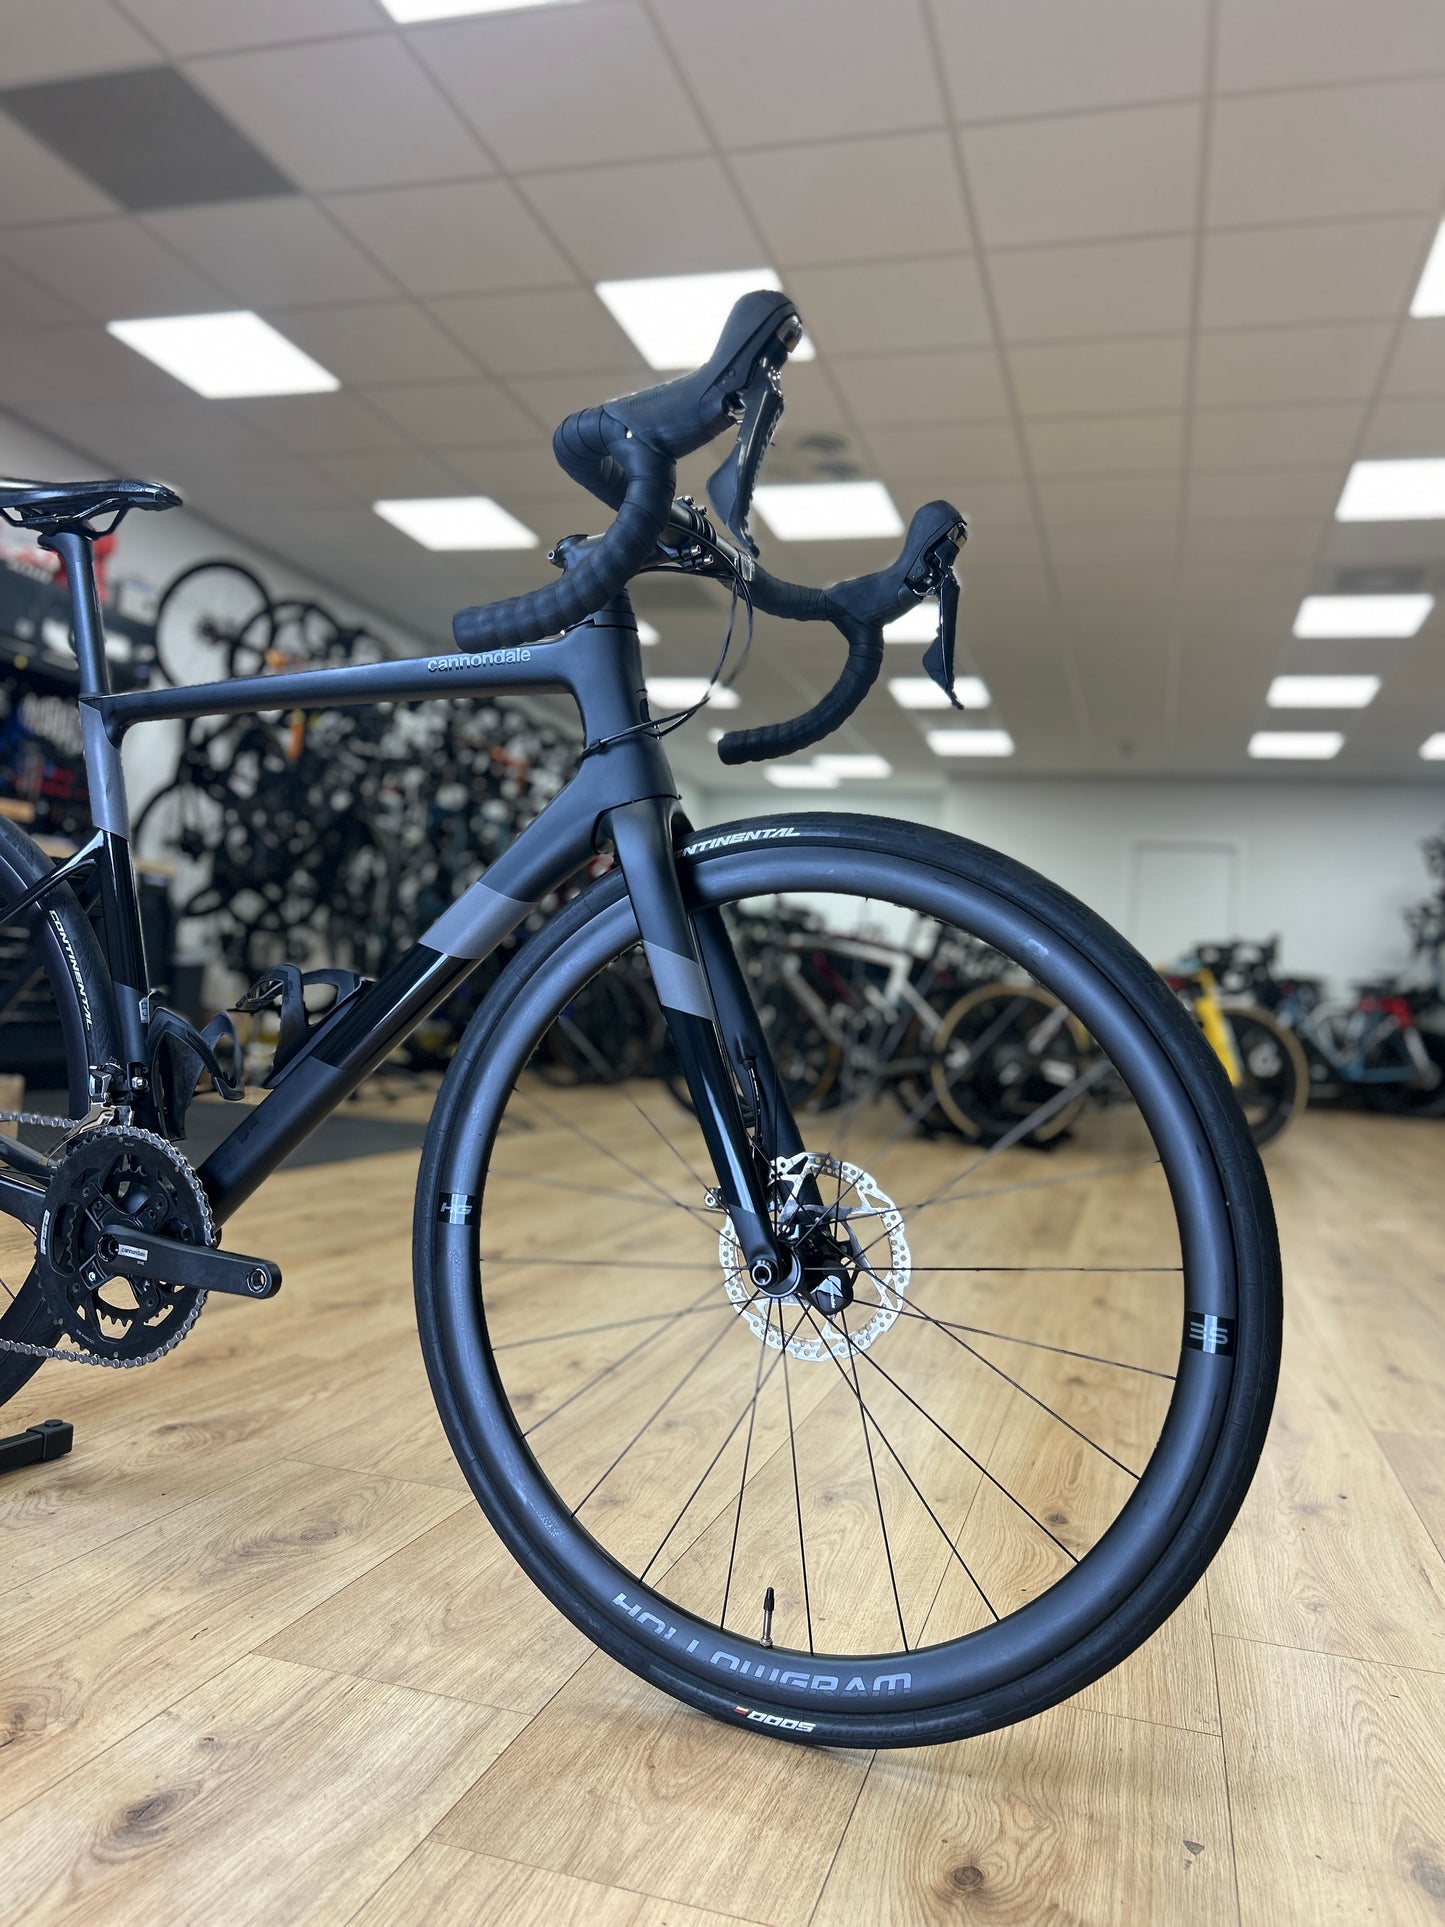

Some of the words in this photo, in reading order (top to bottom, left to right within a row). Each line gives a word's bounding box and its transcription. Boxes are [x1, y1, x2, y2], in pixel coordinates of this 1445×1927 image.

[428, 647, 531, 671] cannondale
[49, 910, 92, 1031] CONTINENTAL
[1189, 1321, 1228, 1345] 35
[611, 1592, 912, 1697] HOLLOWGRAM
[747, 1710, 816, 1733] 5000
